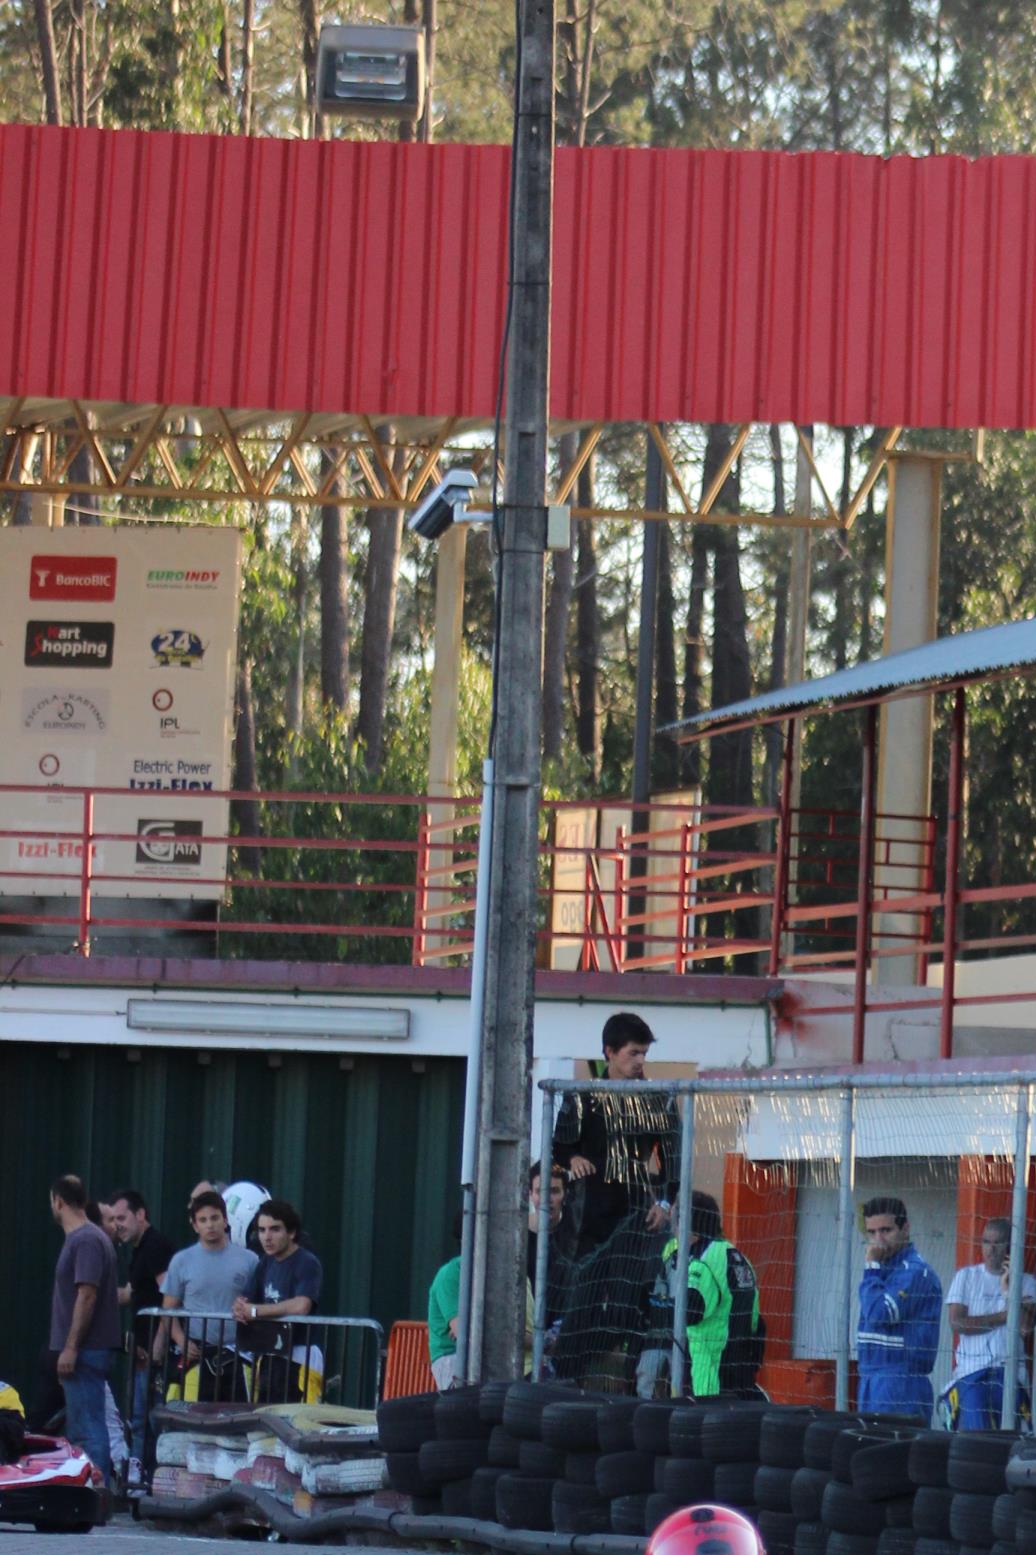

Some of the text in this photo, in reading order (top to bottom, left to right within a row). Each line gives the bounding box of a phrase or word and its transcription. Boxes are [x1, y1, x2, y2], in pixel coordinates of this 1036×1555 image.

[56, 573, 111, 588] BancoBIC
[148, 570, 220, 581] EUROINDY
[31, 632, 108, 658] Shopping
[160, 717, 180, 730] IPL
[134, 759, 212, 775] Electric Power
